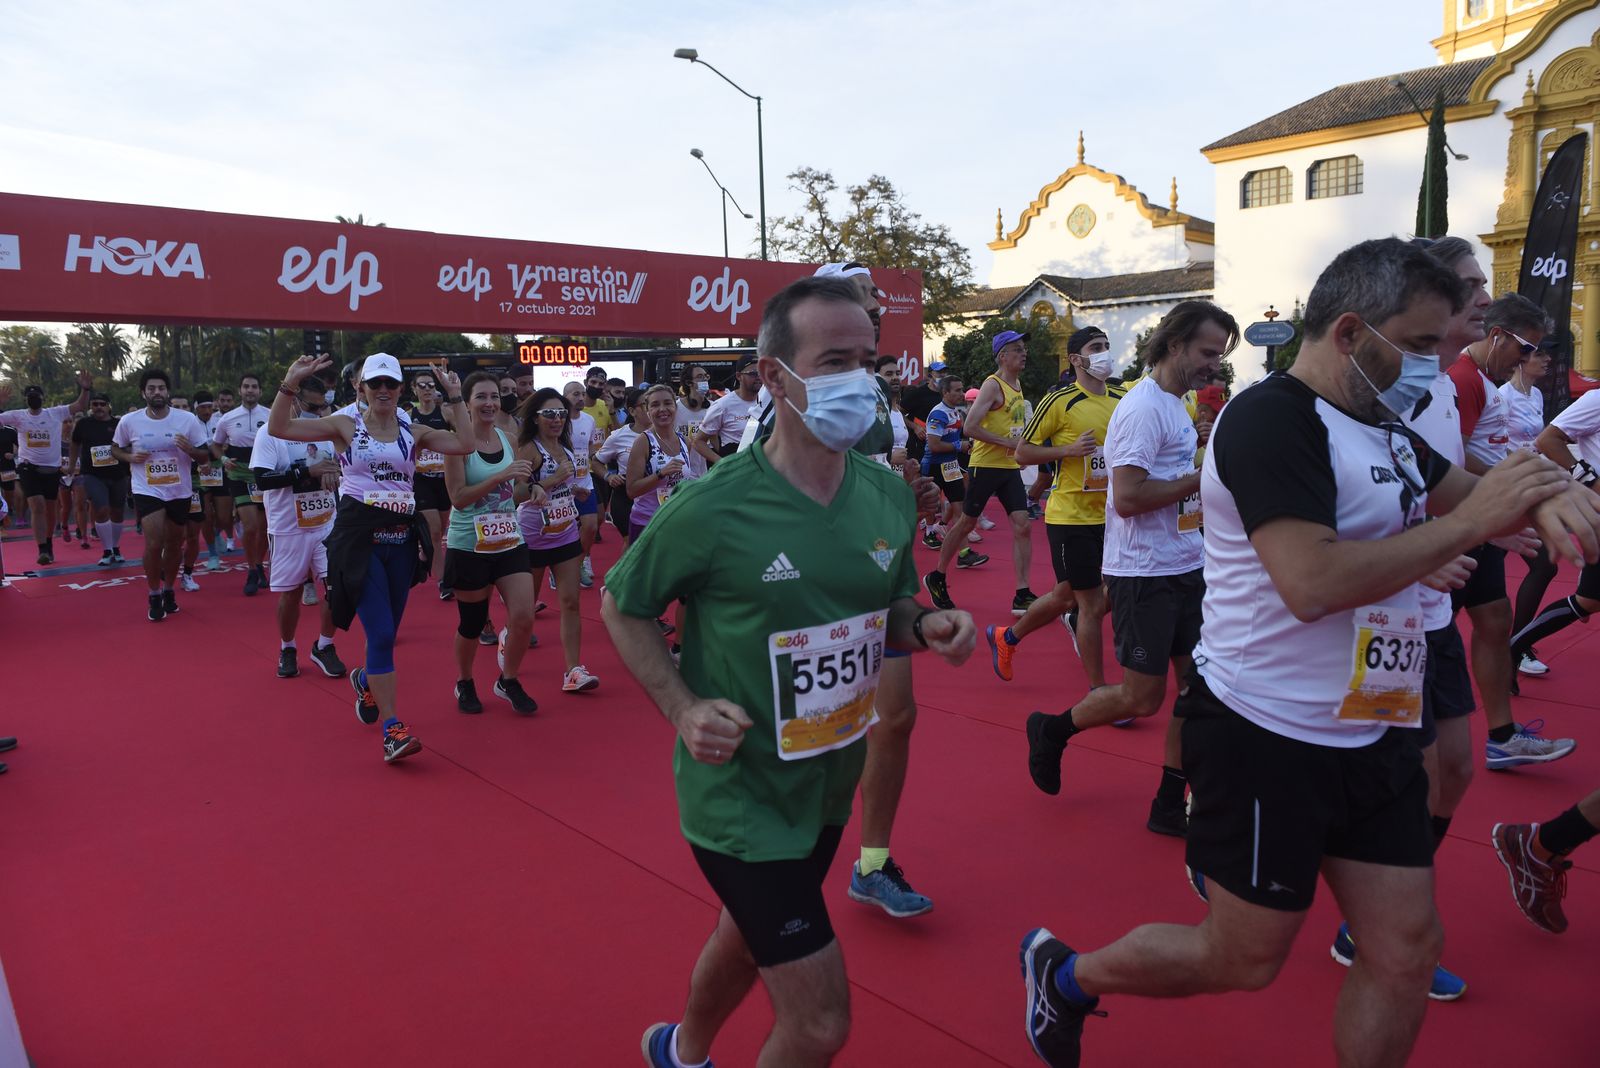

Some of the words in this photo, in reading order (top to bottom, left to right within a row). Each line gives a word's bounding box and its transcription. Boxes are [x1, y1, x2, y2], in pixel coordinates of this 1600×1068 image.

[64, 233, 205, 279] HOKA
[277, 235, 383, 311] edp
[437, 258, 492, 302] edp
[536, 264, 628, 287] maratón
[1530, 251, 1568, 286] edp
[687, 266, 752, 325] edp
[499, 302, 513, 313] 17
[517, 302, 566, 315] octubre
[569, 304, 597, 316] 2021
[300, 498, 330, 512] 3535
[481, 521, 512, 537] 6258
[762, 571, 801, 582] adidas
[830, 621, 849, 640] edp
[1368, 611, 1389, 628] edp
[793, 643, 868, 695] 5551
